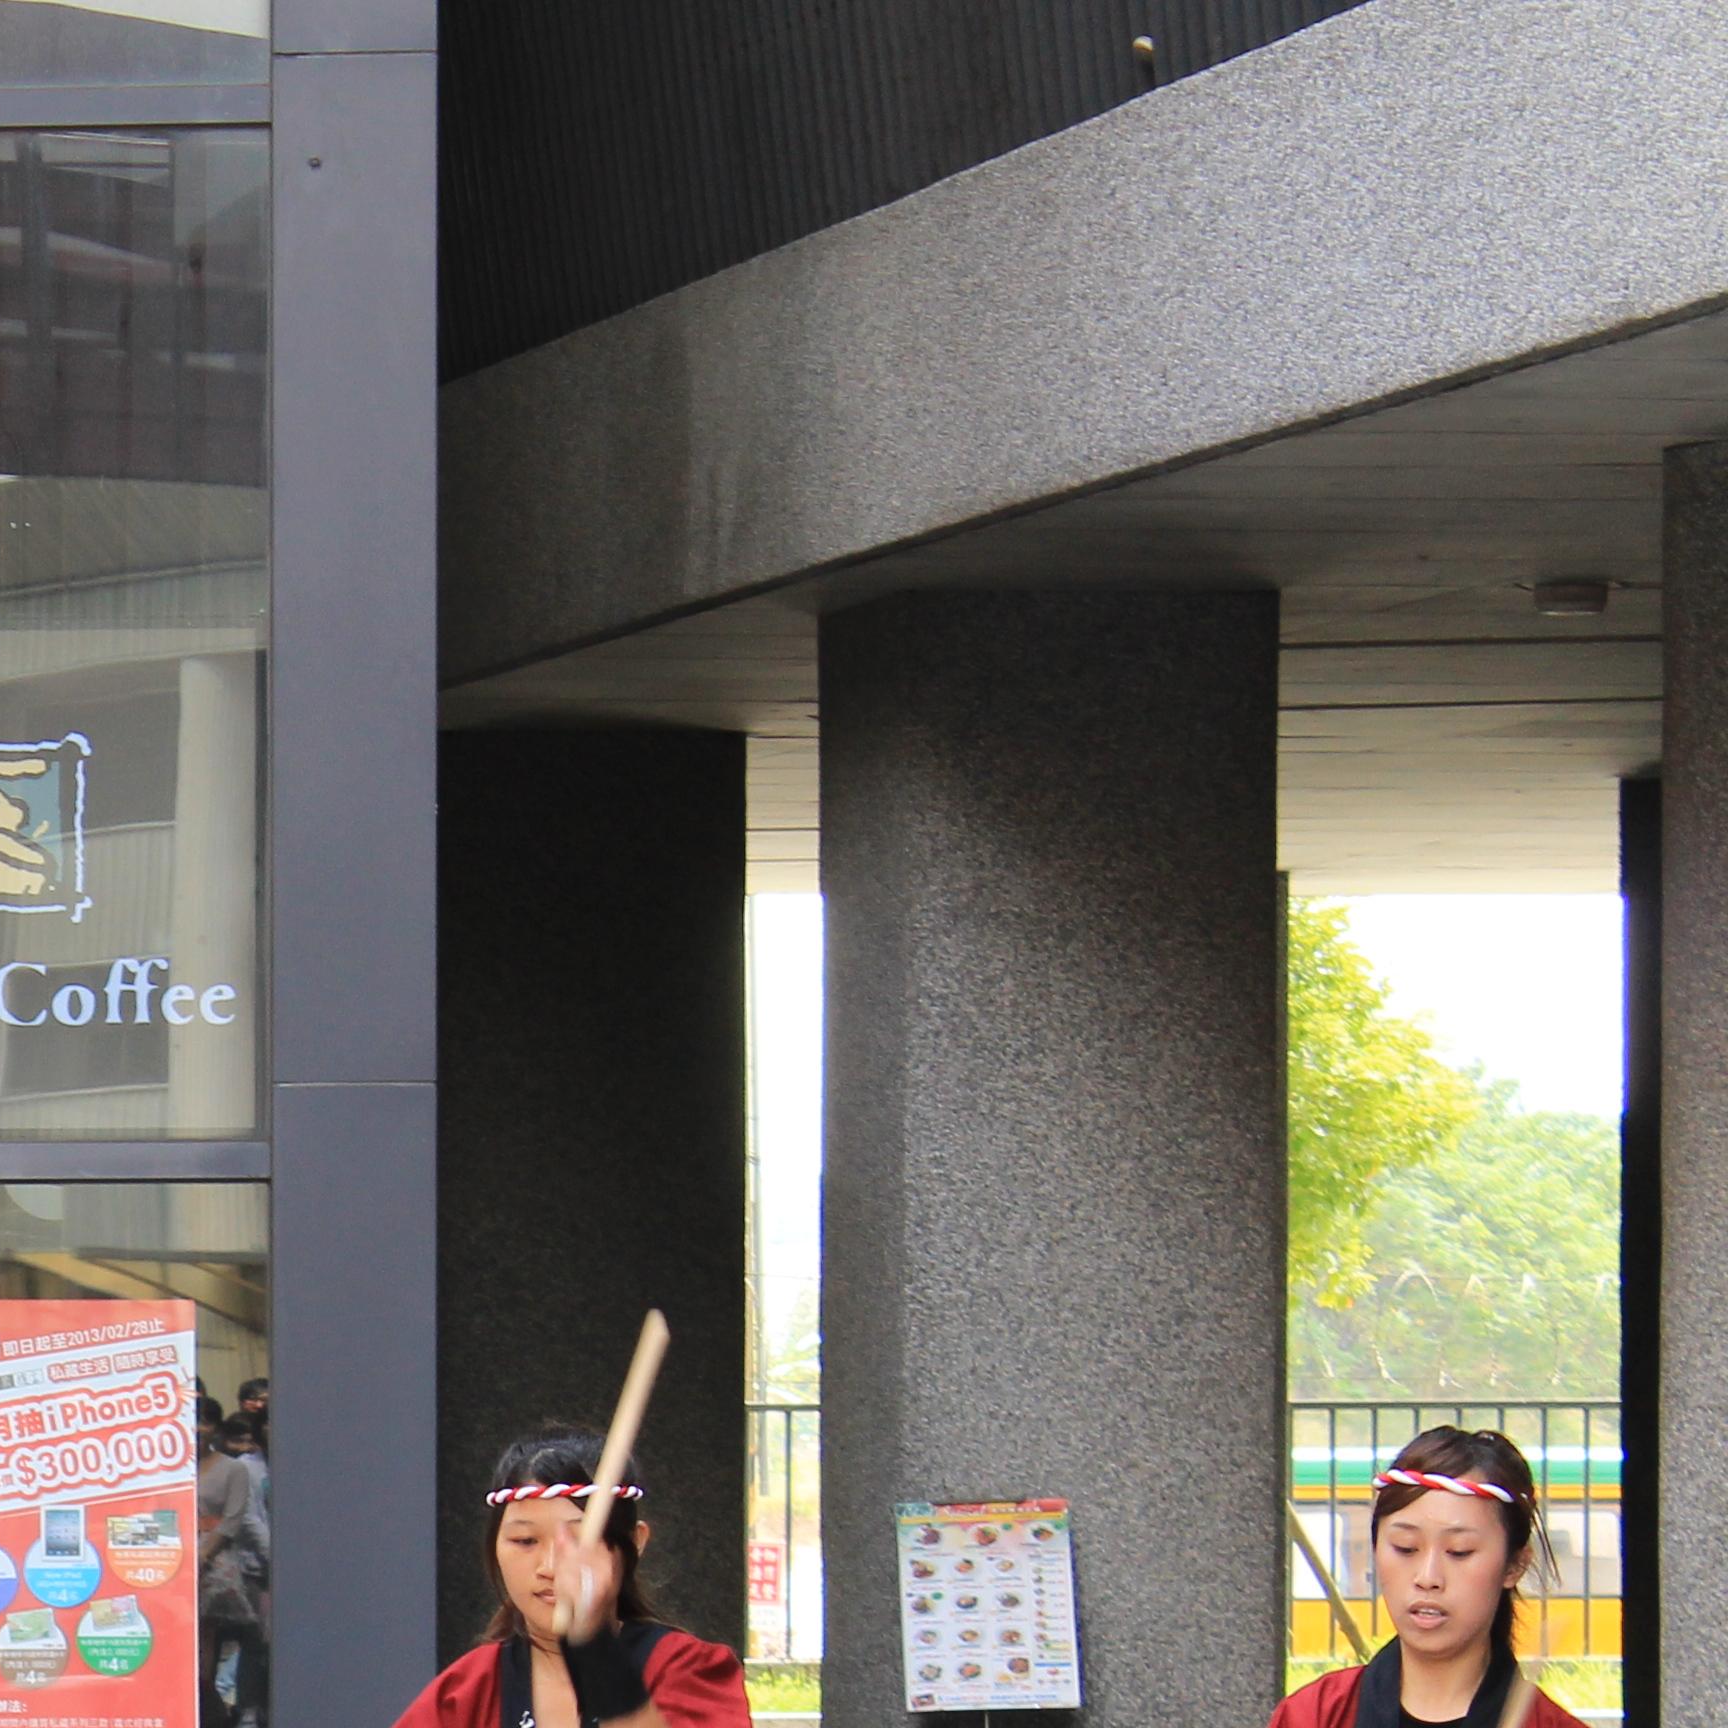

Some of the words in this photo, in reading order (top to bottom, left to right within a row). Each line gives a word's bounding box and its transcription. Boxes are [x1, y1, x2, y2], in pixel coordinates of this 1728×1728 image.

[2, 1318, 166, 1357] 即日起至2013/02/28止
[16, 1430, 177, 1487] $300,000
